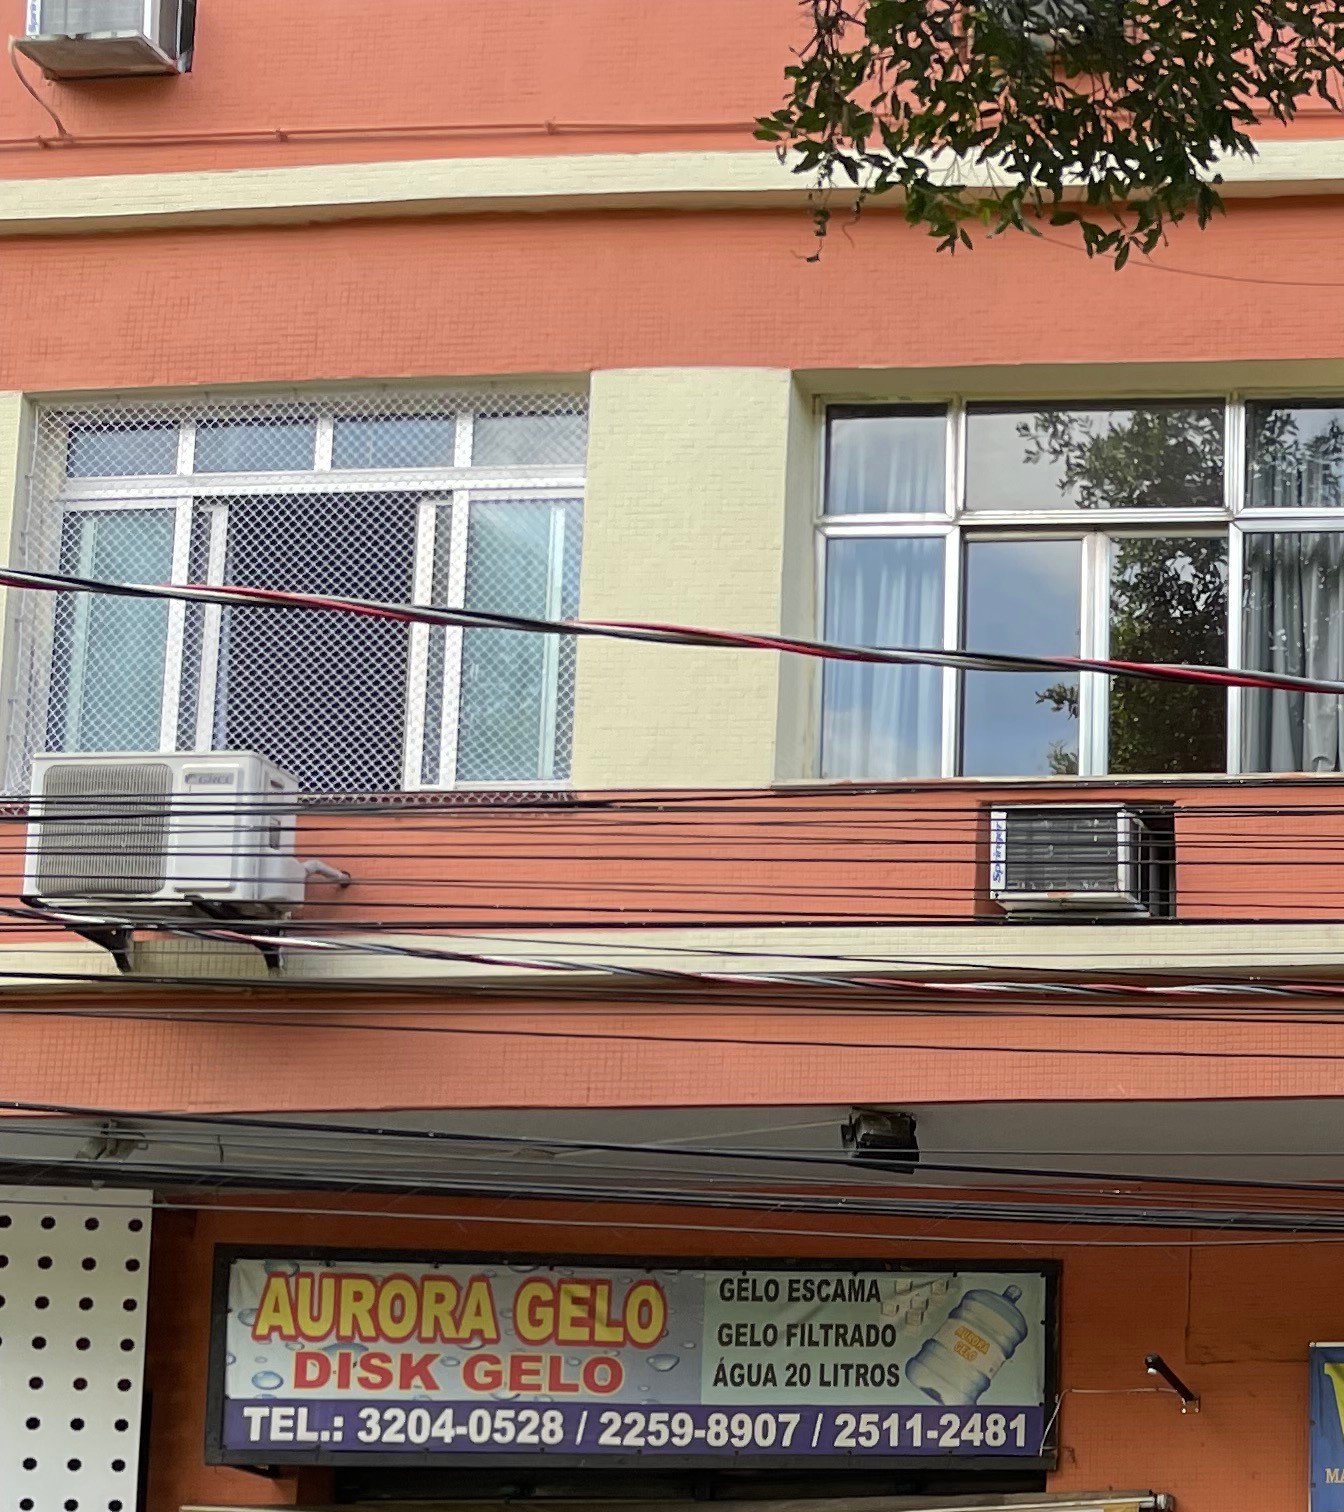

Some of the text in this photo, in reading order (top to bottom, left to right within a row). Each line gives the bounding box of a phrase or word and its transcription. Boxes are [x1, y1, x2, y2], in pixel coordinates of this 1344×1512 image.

[719, 1278, 881, 1303] GELO ESCAMA
[252, 1272, 667, 1347] AURORA GELO
[717, 1323, 896, 1348] GELO FILTRADO
[293, 1350, 625, 1394] DISK GELO
[713, 1357, 900, 1388] ÁGUA 20 LITROS
[243, 1406, 1027, 1448] TEL.: 3204-0528 / 2259-8907 / 2511-2481
